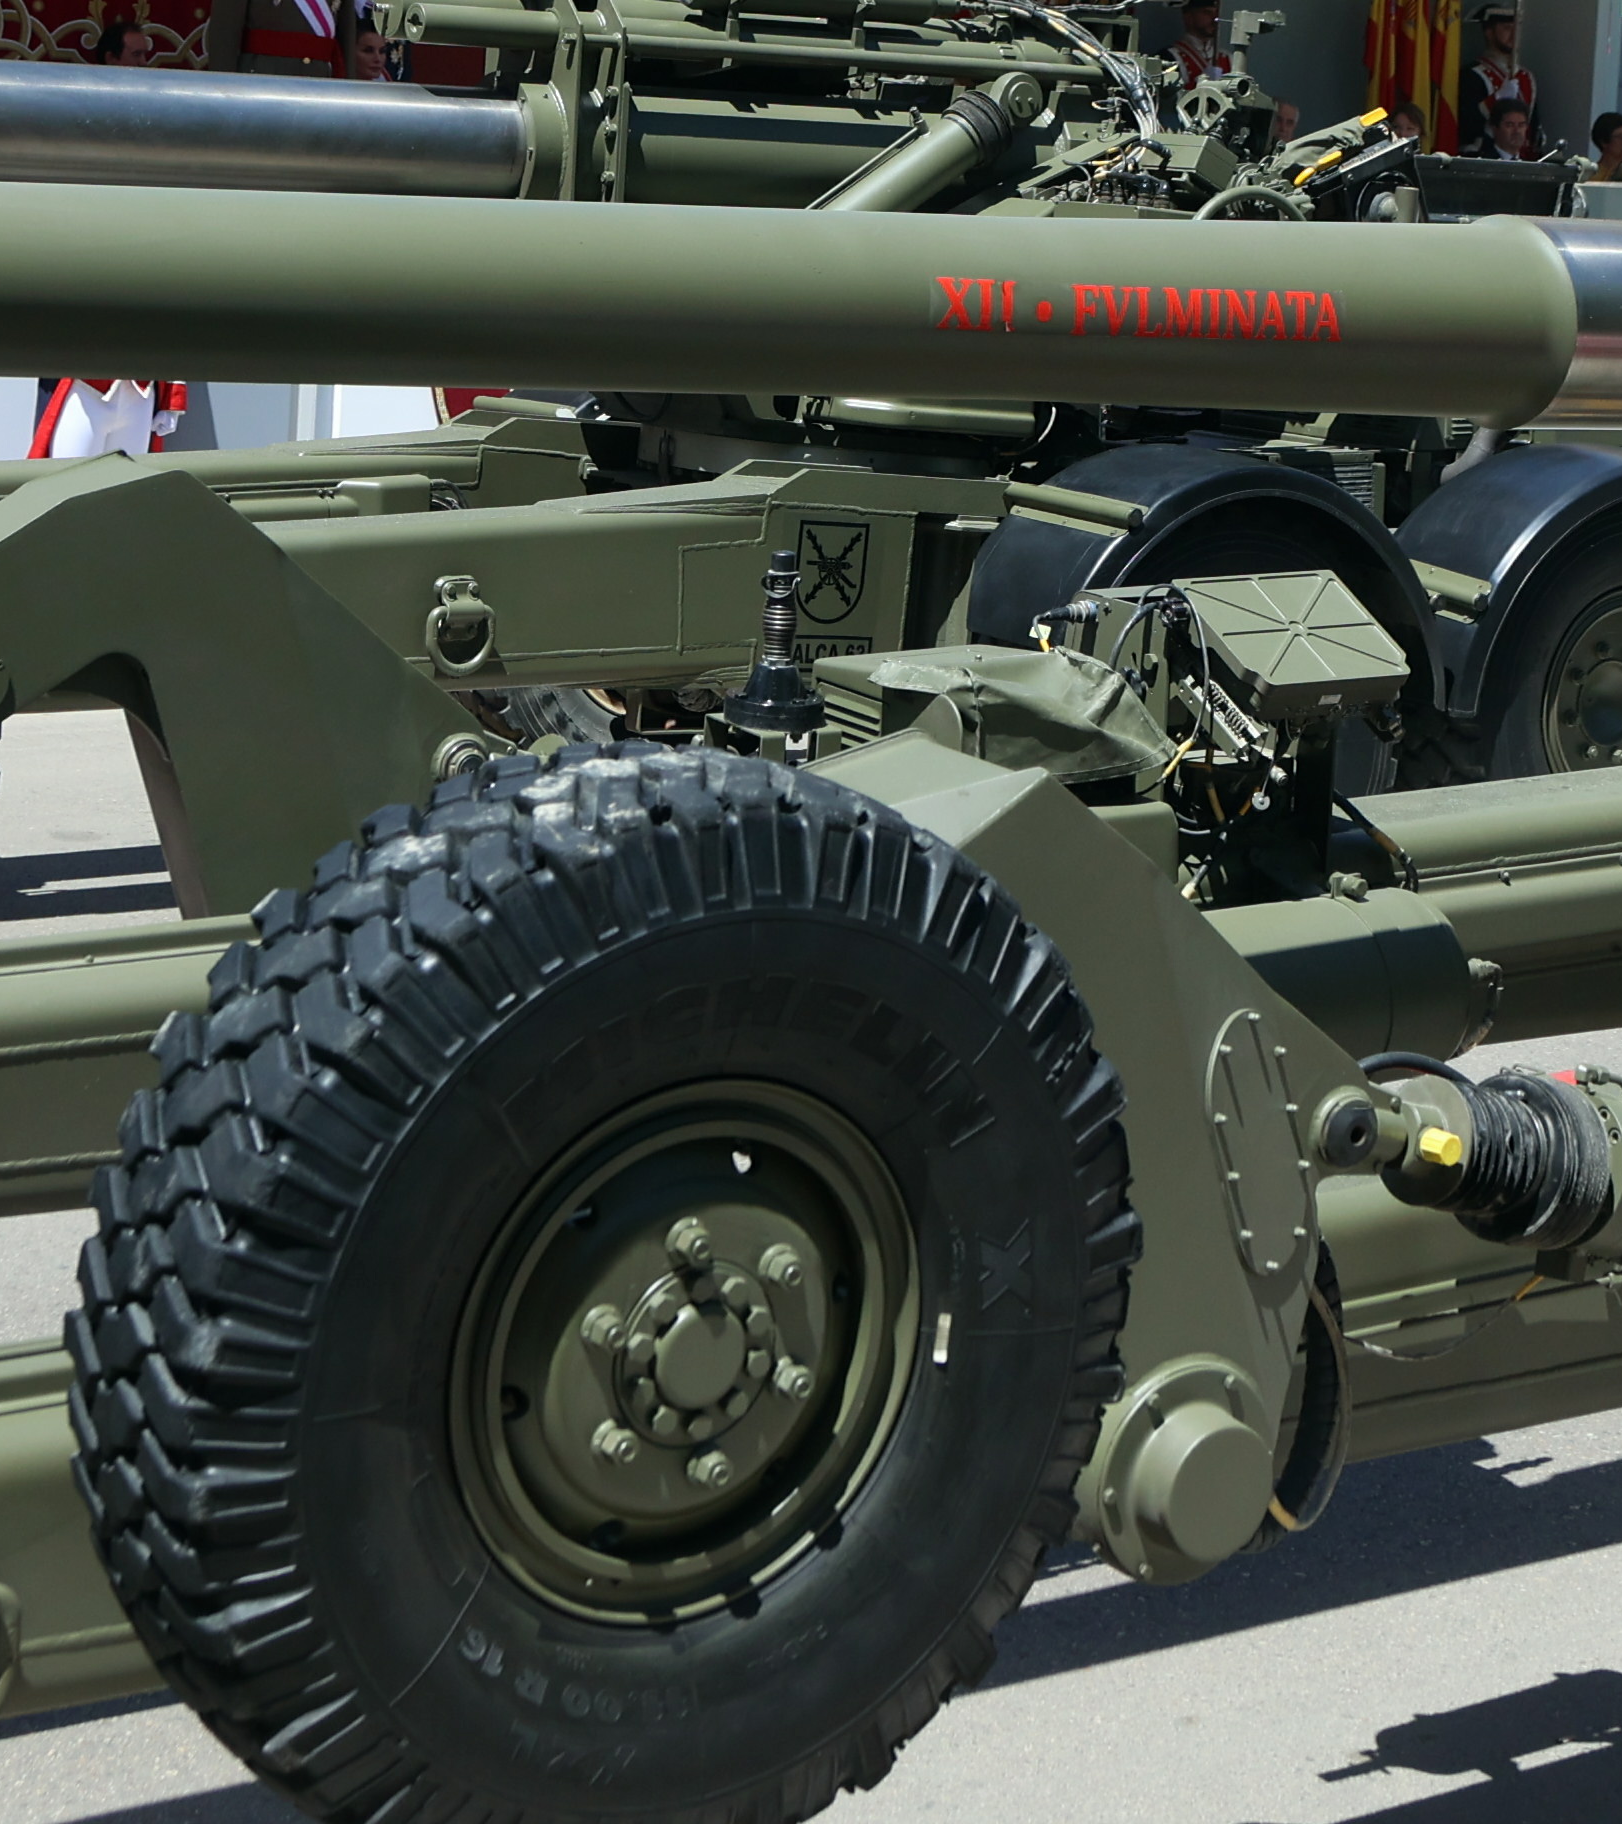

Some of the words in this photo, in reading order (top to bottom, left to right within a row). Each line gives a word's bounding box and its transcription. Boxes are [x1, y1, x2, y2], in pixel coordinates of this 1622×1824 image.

[935, 276, 1017, 332] XII
[1070, 283, 1342, 343] FVLMINATA
[792, 643, 839, 664] ALCA
